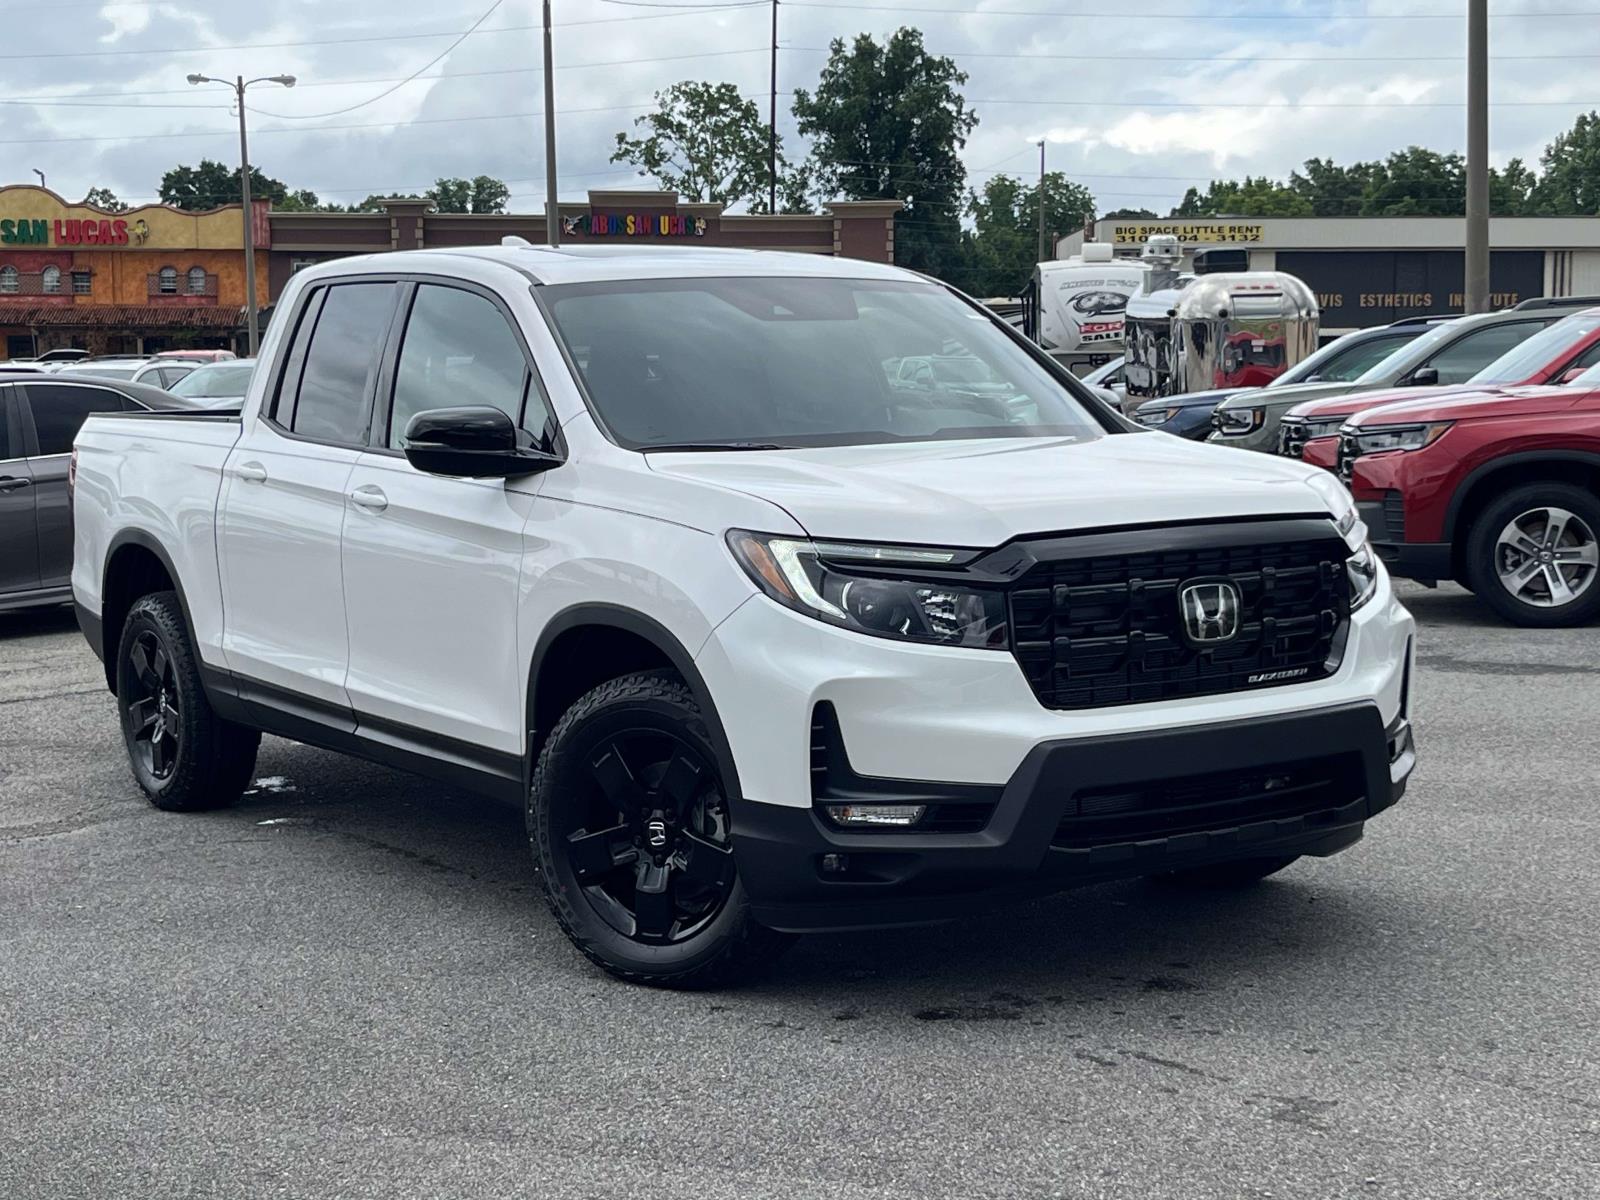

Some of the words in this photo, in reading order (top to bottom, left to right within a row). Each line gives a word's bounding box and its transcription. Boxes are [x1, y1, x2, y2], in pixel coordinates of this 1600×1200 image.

[626, 214, 652, 235] SAN
[655, 214, 695, 235] LUCAS
[1115, 226, 1137, 235] BIG
[1140, 226, 1179, 235] SPACE
[1183, 225, 1225, 234] LITTLE
[1228, 225, 1262, 234] RENT
[0, 219, 48, 244] SAN
[54, 219, 129, 245] LUCAS
[1215, 234, 1260, 242] 3132
[1314, 294, 1343, 307] VIS
[1360, 293, 1432, 307] ESTHETICS
[1449, 293, 1519, 307] INUTE
